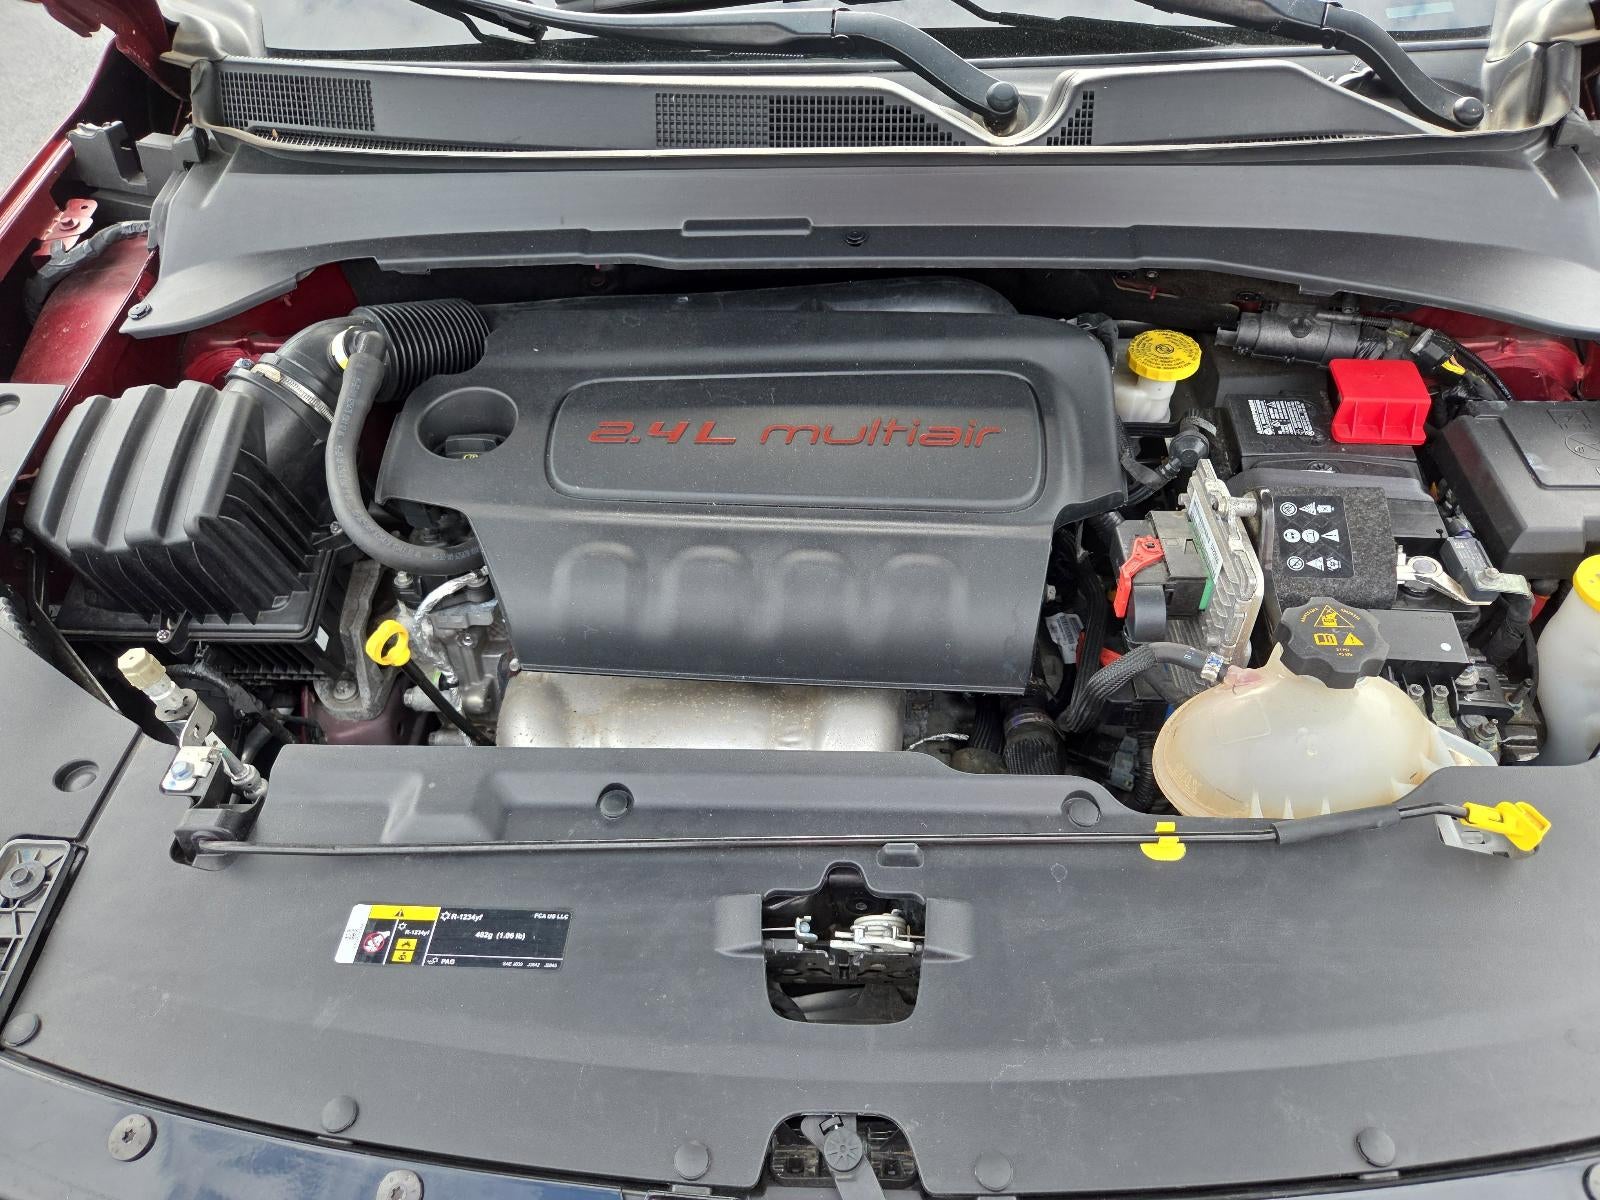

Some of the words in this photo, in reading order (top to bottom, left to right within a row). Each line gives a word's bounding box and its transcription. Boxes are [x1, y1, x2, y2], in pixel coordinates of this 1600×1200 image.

[586, 420, 737, 446] 2.4L
[759, 417, 1001, 448] multiair
[450, 913, 484, 922] R-1234yf
